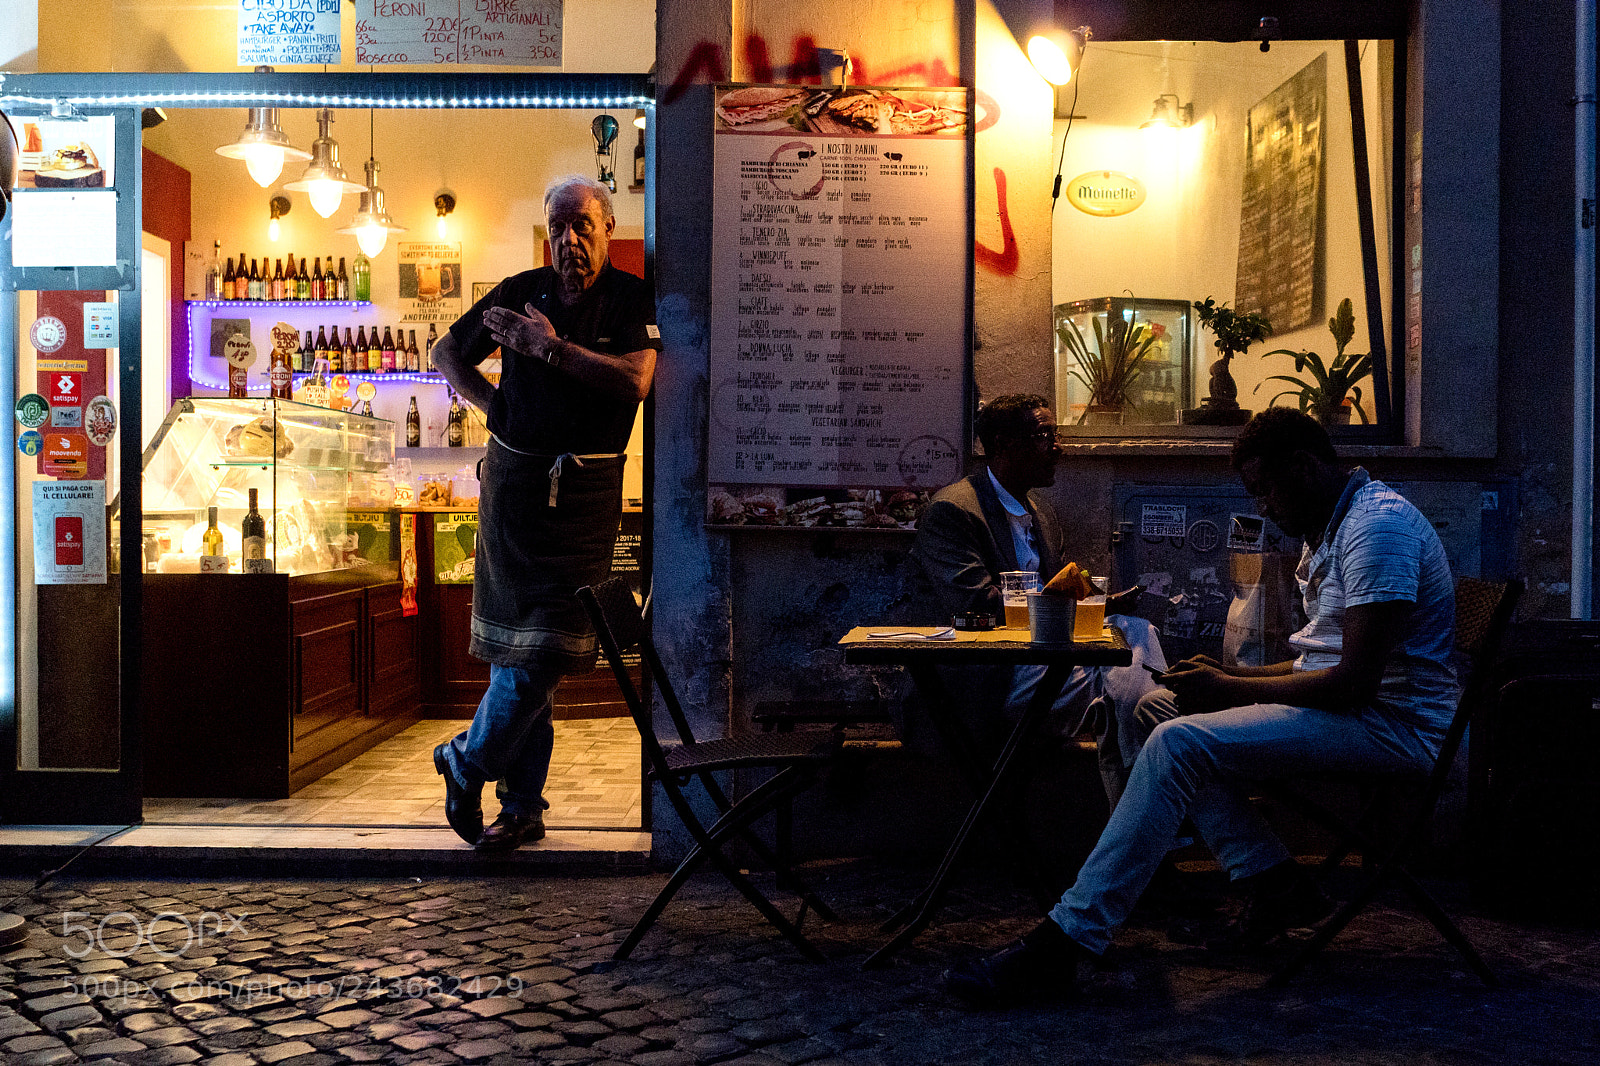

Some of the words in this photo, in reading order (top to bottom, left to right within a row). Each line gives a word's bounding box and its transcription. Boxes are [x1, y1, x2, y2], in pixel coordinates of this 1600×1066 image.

[289, 0, 312, 10] DA
[374, 0, 425, 18] PERONI
[257, 10, 315, 23] ASPORTO
[484, 11, 550, 26] ARTIGIANALI
[355, 46, 408, 64] PROSECCO
[471, 45, 505, 58] PINTA
[827, 143, 852, 154] NOSTRI
[855, 144, 878, 155] PANINI
[1078, 186, 1137, 200] Moinette
[402, 313, 438, 321] ANOTHER
[53, 395, 79, 404] satispay
[57, 541, 81, 549] satispay
